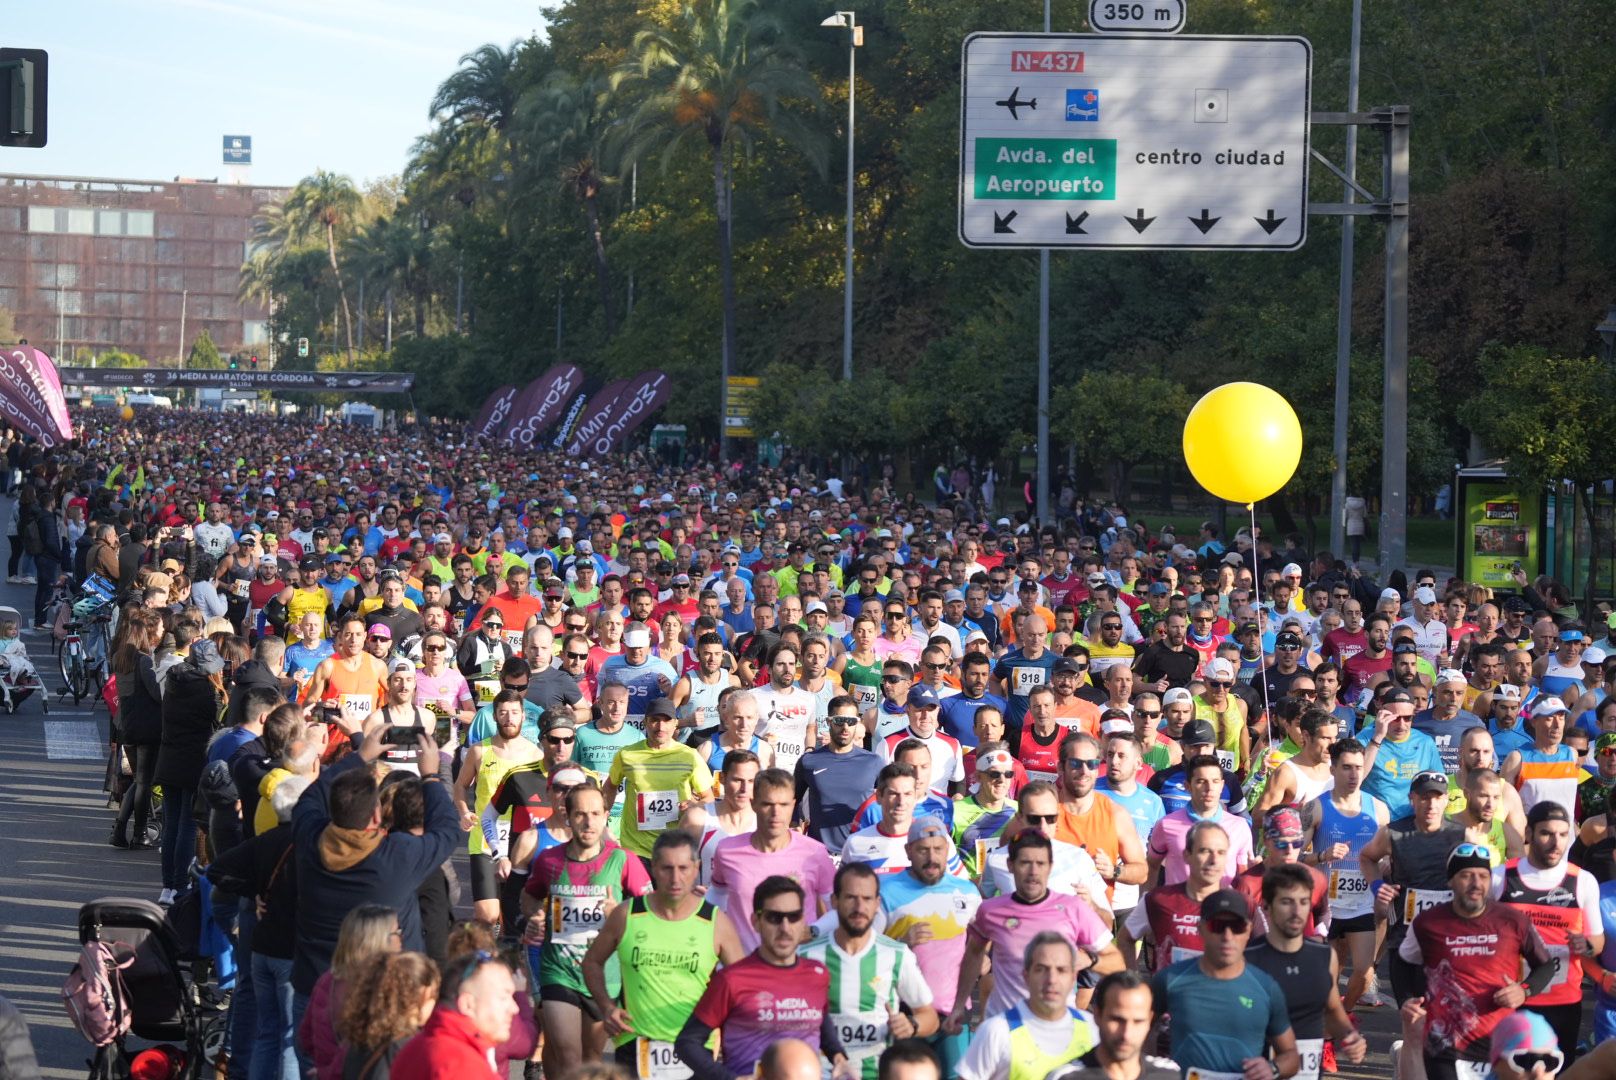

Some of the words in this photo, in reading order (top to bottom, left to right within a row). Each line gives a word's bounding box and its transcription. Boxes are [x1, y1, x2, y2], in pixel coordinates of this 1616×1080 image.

[1104, 4, 1144, 21] 350
[1154, 8, 1171, 21] m
[1016, 53, 1080, 70] N-437
[997, 146, 1052, 165] Avda.
[1062, 147, 1095, 164] del
[1135, 149, 1201, 166] centro
[1215, 149, 1284, 166] ciudad
[986, 176, 1104, 197] Aeropuerto
[210, 371, 255, 382] MARATÓN
[270, 373, 315, 383] CÓRDOBA
[520, 366, 577, 444] IMDECO
[595, 374, 665, 455] IMDECO
[1487, 511, 1518, 520] FRIDAY
[1021, 673, 1040, 683] 918
[861, 692, 876, 702] 792
[777, 741, 801, 755] 1008
[649, 799, 672, 813] 423
[1337, 877, 1368, 891] 2369
[562, 906, 602, 922] 2166
[1445, 934, 1498, 945] LOGOS
[1450, 946, 1496, 957] TRAIL
[776, 998, 808, 1009] MEDIA
[758, 1009, 774, 1021] 36
[777, 1007, 822, 1021] MARATÓN
